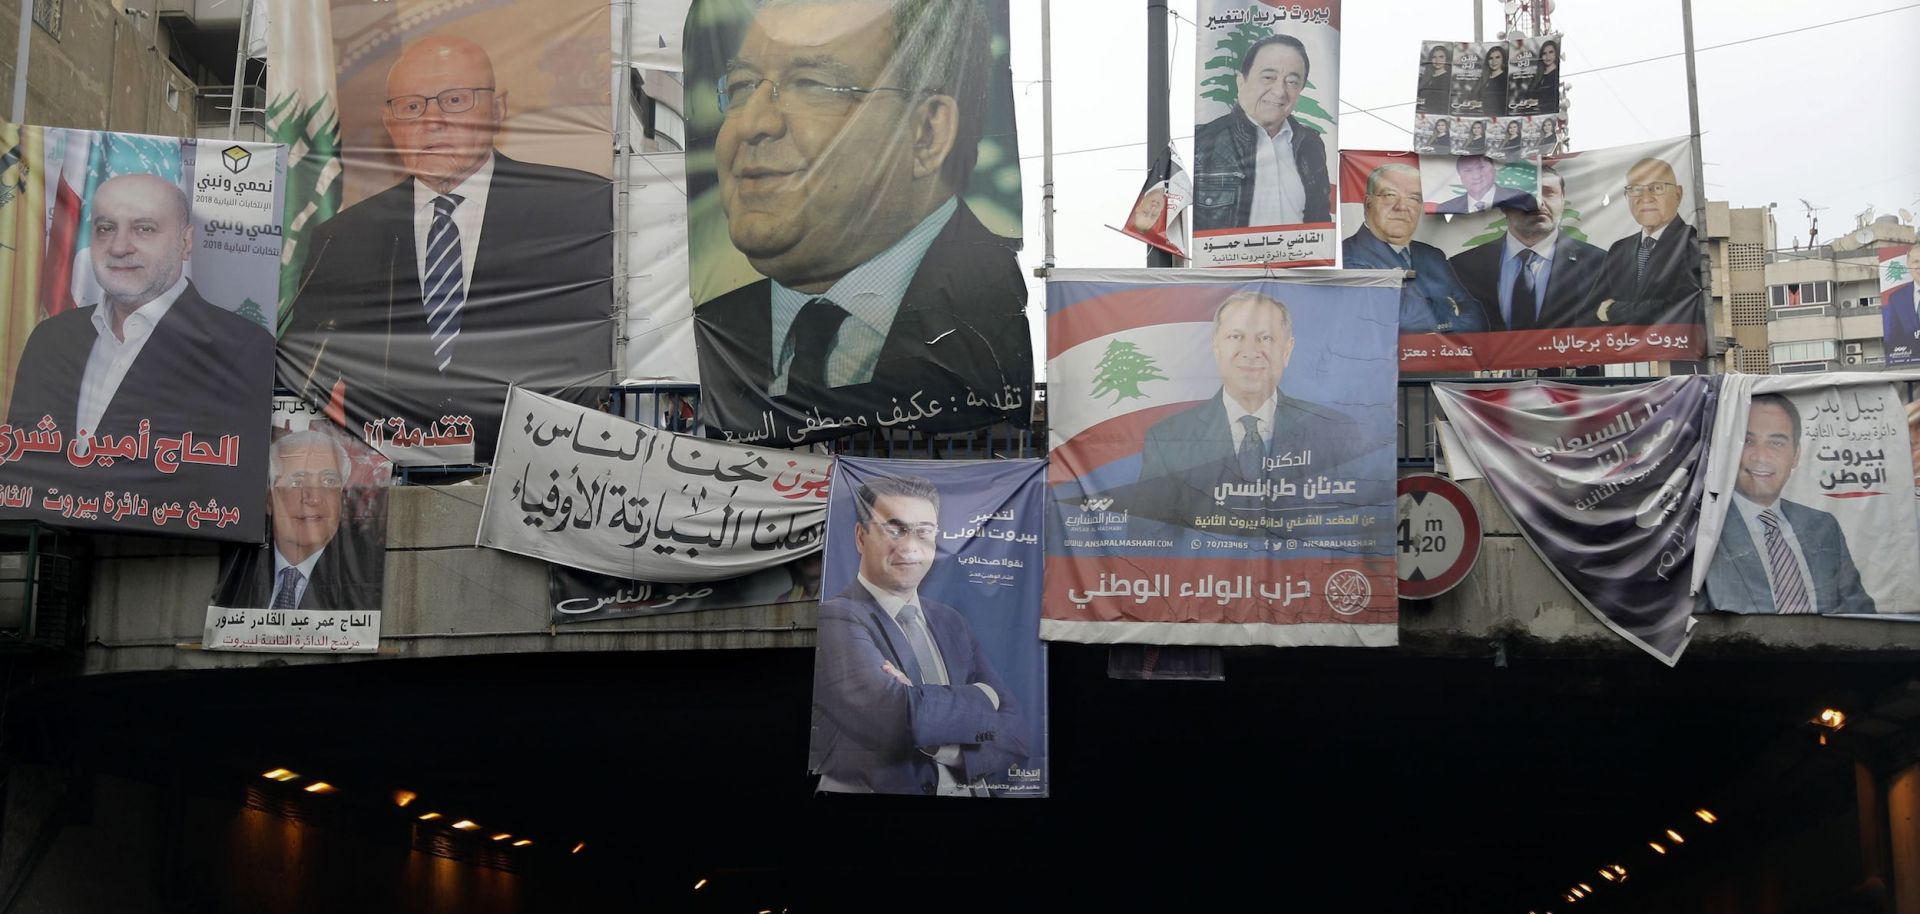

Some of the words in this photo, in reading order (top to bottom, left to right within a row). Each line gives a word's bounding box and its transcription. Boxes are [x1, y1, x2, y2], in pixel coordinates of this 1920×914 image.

[1205, 10, 1250, 30] التغيير
[1253, 7, 1287, 26] تريد
[1290, 6, 1329, 23] بيروت
[197, 173, 232, 193] ونبني
[233, 179, 272, 196] نحمي
[195, 194, 213, 204] 2018
[213, 198, 238, 209] النيابية
[245, 223, 283, 241] حمي
[203, 239, 223, 250] 2018
[1286, 232, 1324, 250] القاضي
[1240, 252, 1266, 263] بيروت
[1288, 249, 1314, 261] مرشح
[1605, 335, 1641, 351] حلوة
[1646, 333, 1689, 350] بيروت
[1401, 347, 1428, 361] معتز
[1440, 346, 1473, 358] تقدمة
[876, 390, 943, 429] عكيف
[1808, 398, 1840, 421] بدر
[1846, 392, 1885, 422] نبيل
[388, 415, 475, 449] تقدمة
[1805, 424, 1834, 441] الثانية
[1836, 427, 1871, 441] بيروت
[1872, 423, 1897, 440] دائرة
[67, 419, 150, 468] أمين
[154, 431, 240, 473] الحاج
[1261, 449, 1312, 472] الدكتور
[1817, 445, 1885, 466] بيروت
[1819, 467, 1887, 490] الوطن
[1214, 478, 1297, 506] طرابلسي
[1303, 476, 1357, 500] عدنان
[43, 488, 99, 520] بيروت
[103, 491, 149, 521] دائرة
[511, 461, 611, 534] الأوفياء
[152, 501, 184, 525] عن
[187, 499, 240, 529] مرشح
[1105, 509, 1128, 524] أنصار
[1194, 515, 1226, 528] الثانية
[1325, 514, 1359, 526] المقعد
[1361, 515, 1376, 527] عن
[1229, 516, 1259, 530] بيروت
[1424, 519, 1443, 532] m
[988, 529, 1038, 544] بيروت
[1067, 573, 1170, 609] الوطني
[1179, 574, 1252, 605] الولاء
[1259, 575, 1312, 607] حزب
[215, 611, 247, 628] غندور
[251, 612, 286, 630] القادر
[291, 615, 310, 630] عبد
[315, 616, 335, 631] عمر
[340, 613, 371, 632] الحاج
[223, 636, 259, 648] لبيروت
[260, 635, 292, 646] الثانية
[295, 634, 328, 650] الدائرة
[330, 635, 360, 651] مرشح
